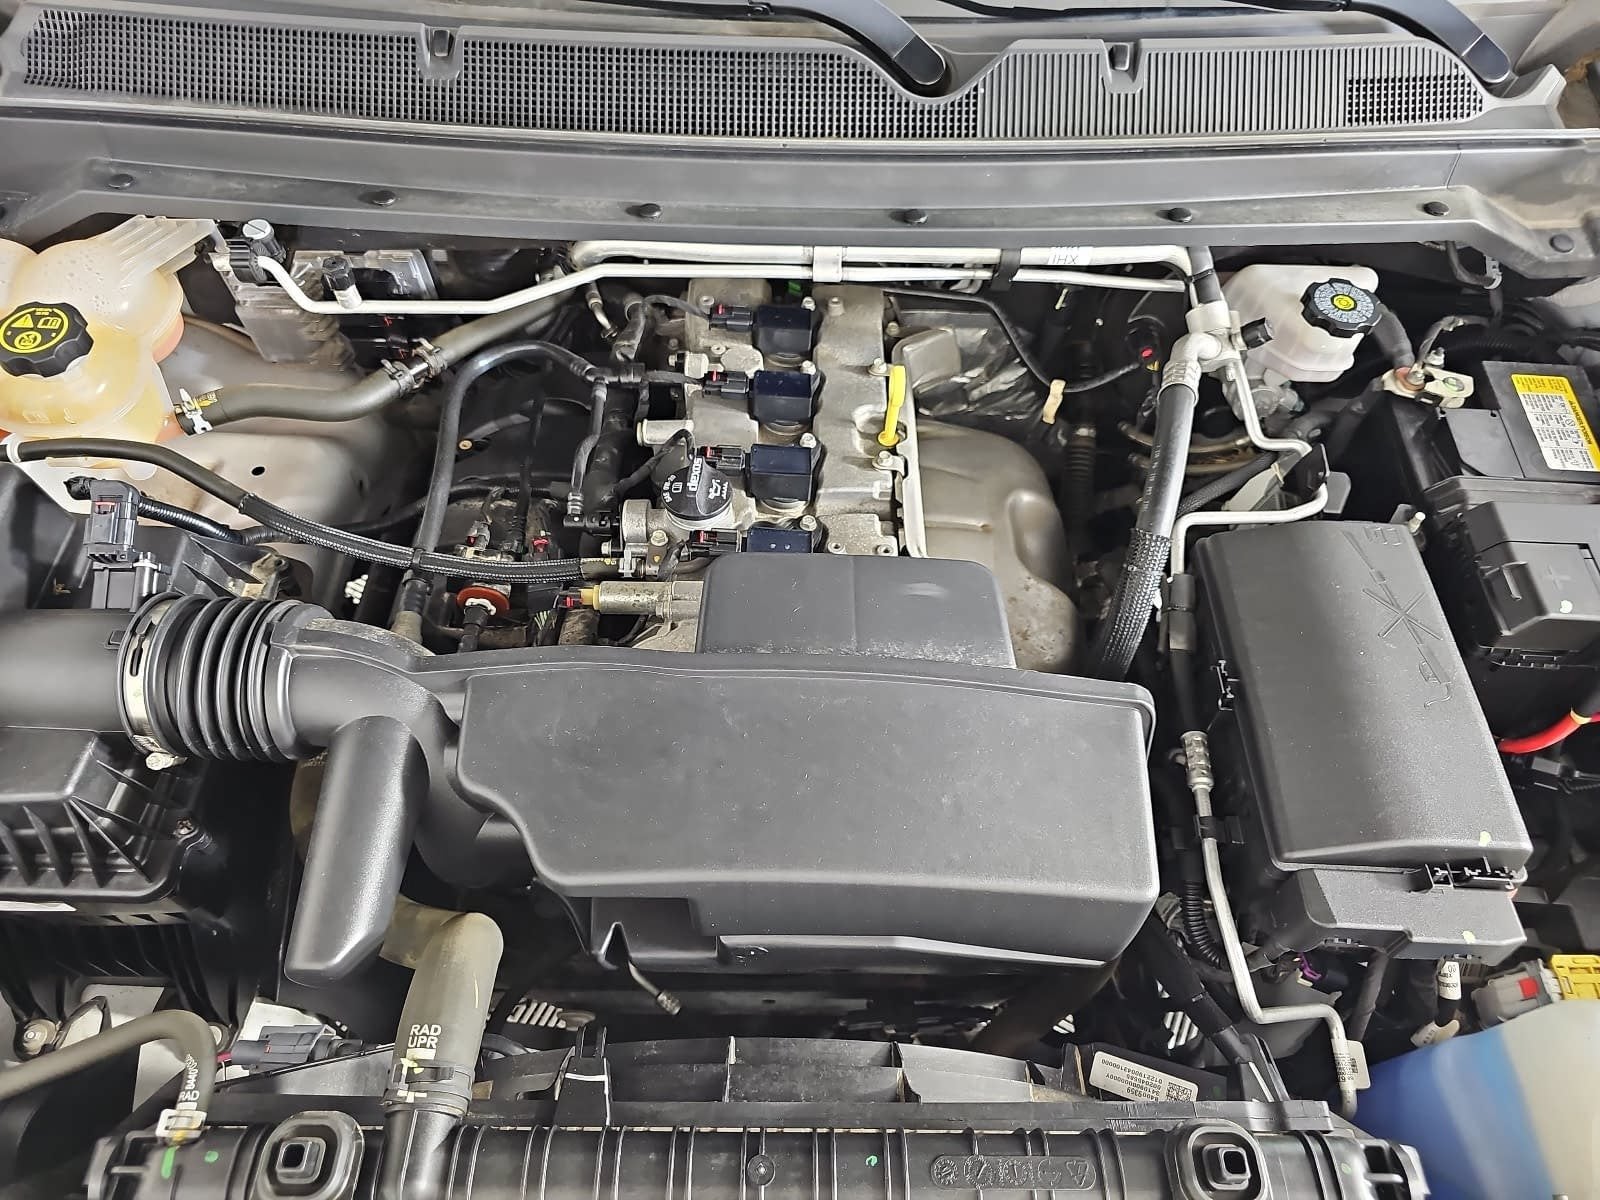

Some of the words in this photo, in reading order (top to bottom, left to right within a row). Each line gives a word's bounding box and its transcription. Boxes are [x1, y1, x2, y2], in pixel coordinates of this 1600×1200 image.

[687, 458, 702, 491] dexos
[410, 1024, 442, 1036] RAD
[408, 1036, 439, 1049] UPR
[178, 1090, 200, 1101] RAD
